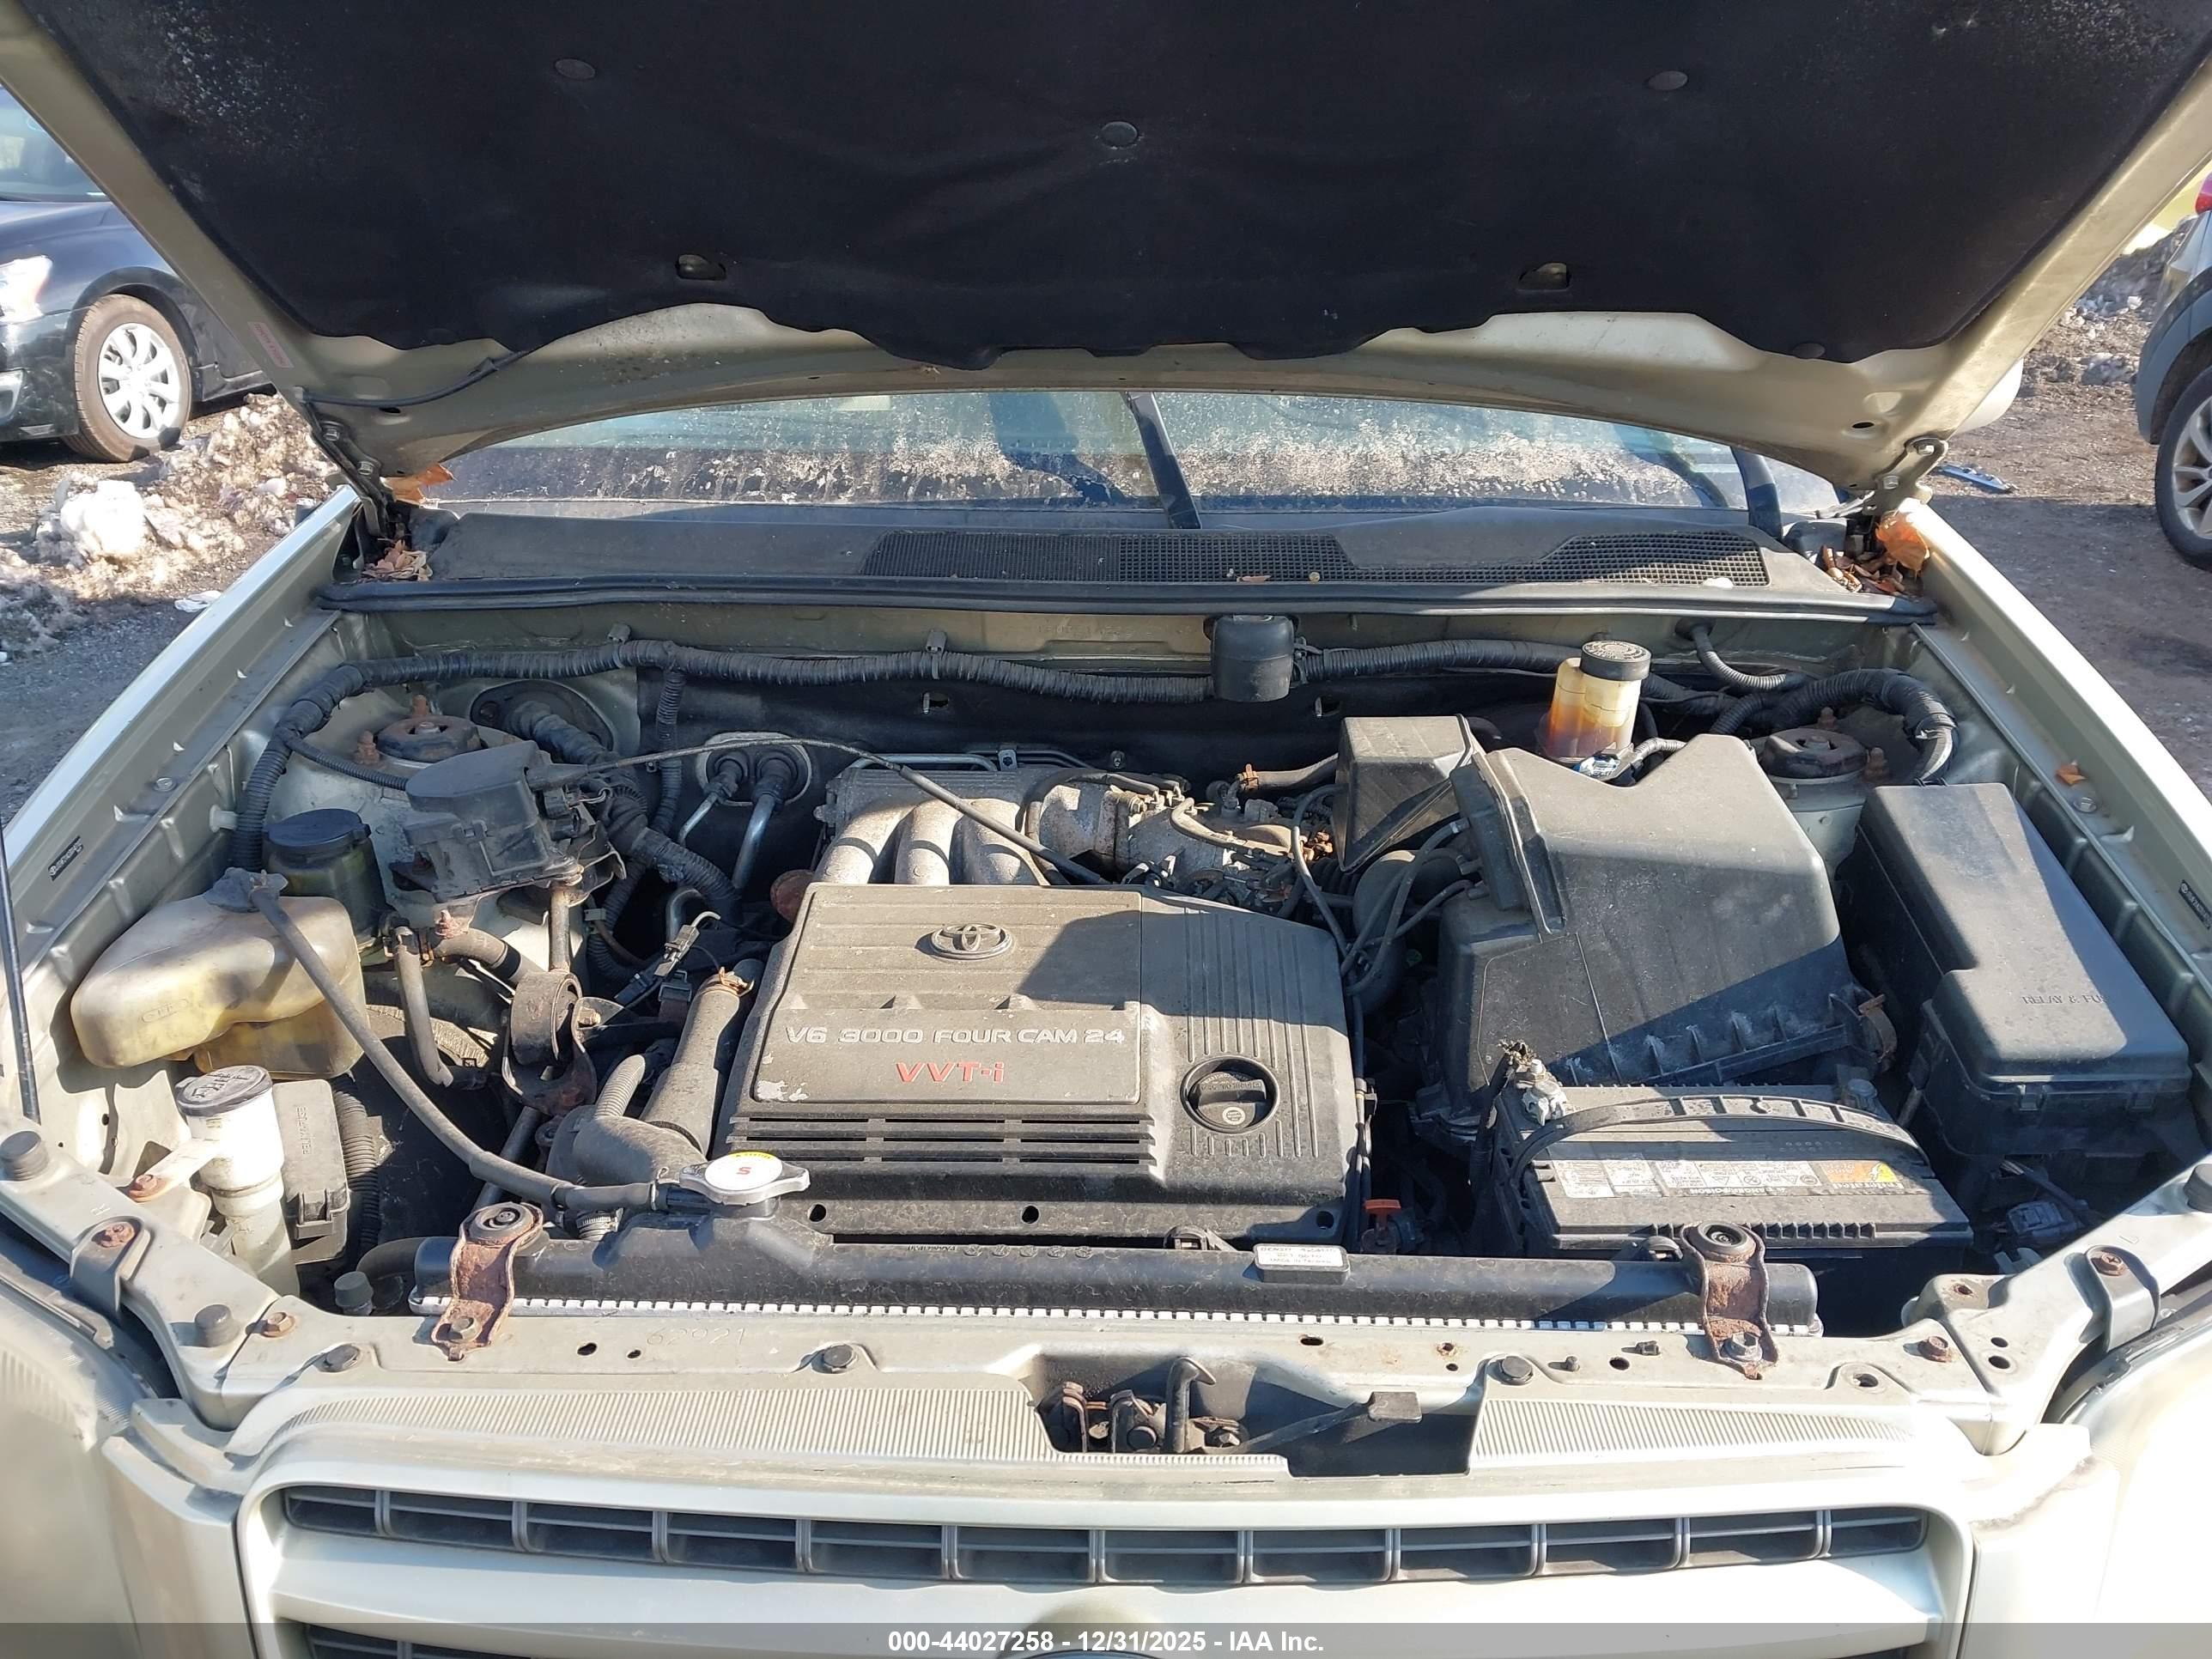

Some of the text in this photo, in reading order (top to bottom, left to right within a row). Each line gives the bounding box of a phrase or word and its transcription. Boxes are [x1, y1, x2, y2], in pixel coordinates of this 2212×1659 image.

[2021, 995, 2063, 1004] RELAY
[786, 1026, 1125, 1044] V6 3000 FOUR CAM 24
[736, 1166, 752, 1176] S
